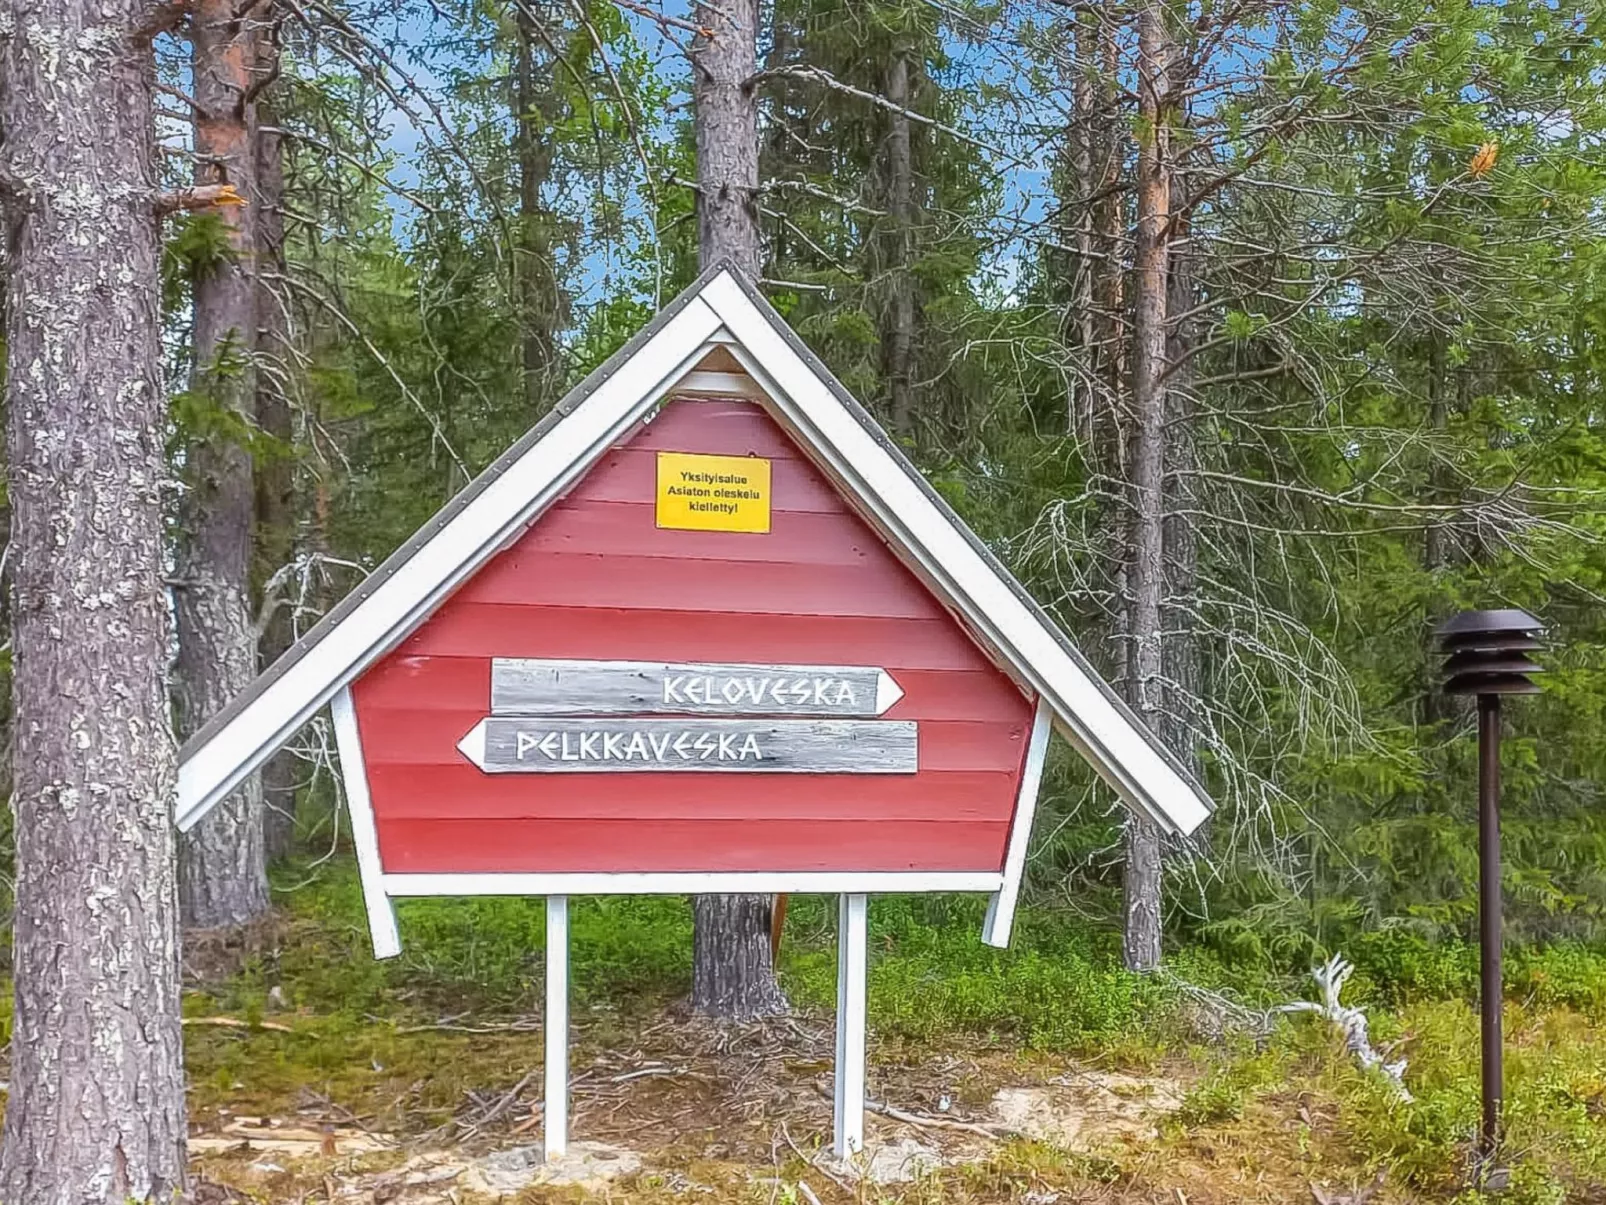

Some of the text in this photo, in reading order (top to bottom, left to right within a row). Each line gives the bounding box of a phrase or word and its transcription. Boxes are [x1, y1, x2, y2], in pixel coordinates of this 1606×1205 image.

[680, 471, 748, 485] Yksityisalue
[667, 485, 760, 499] Asiaton oleskelu
[662, 676, 856, 706] KELOVESKA
[515, 730, 764, 762] PELKKAVESKA
